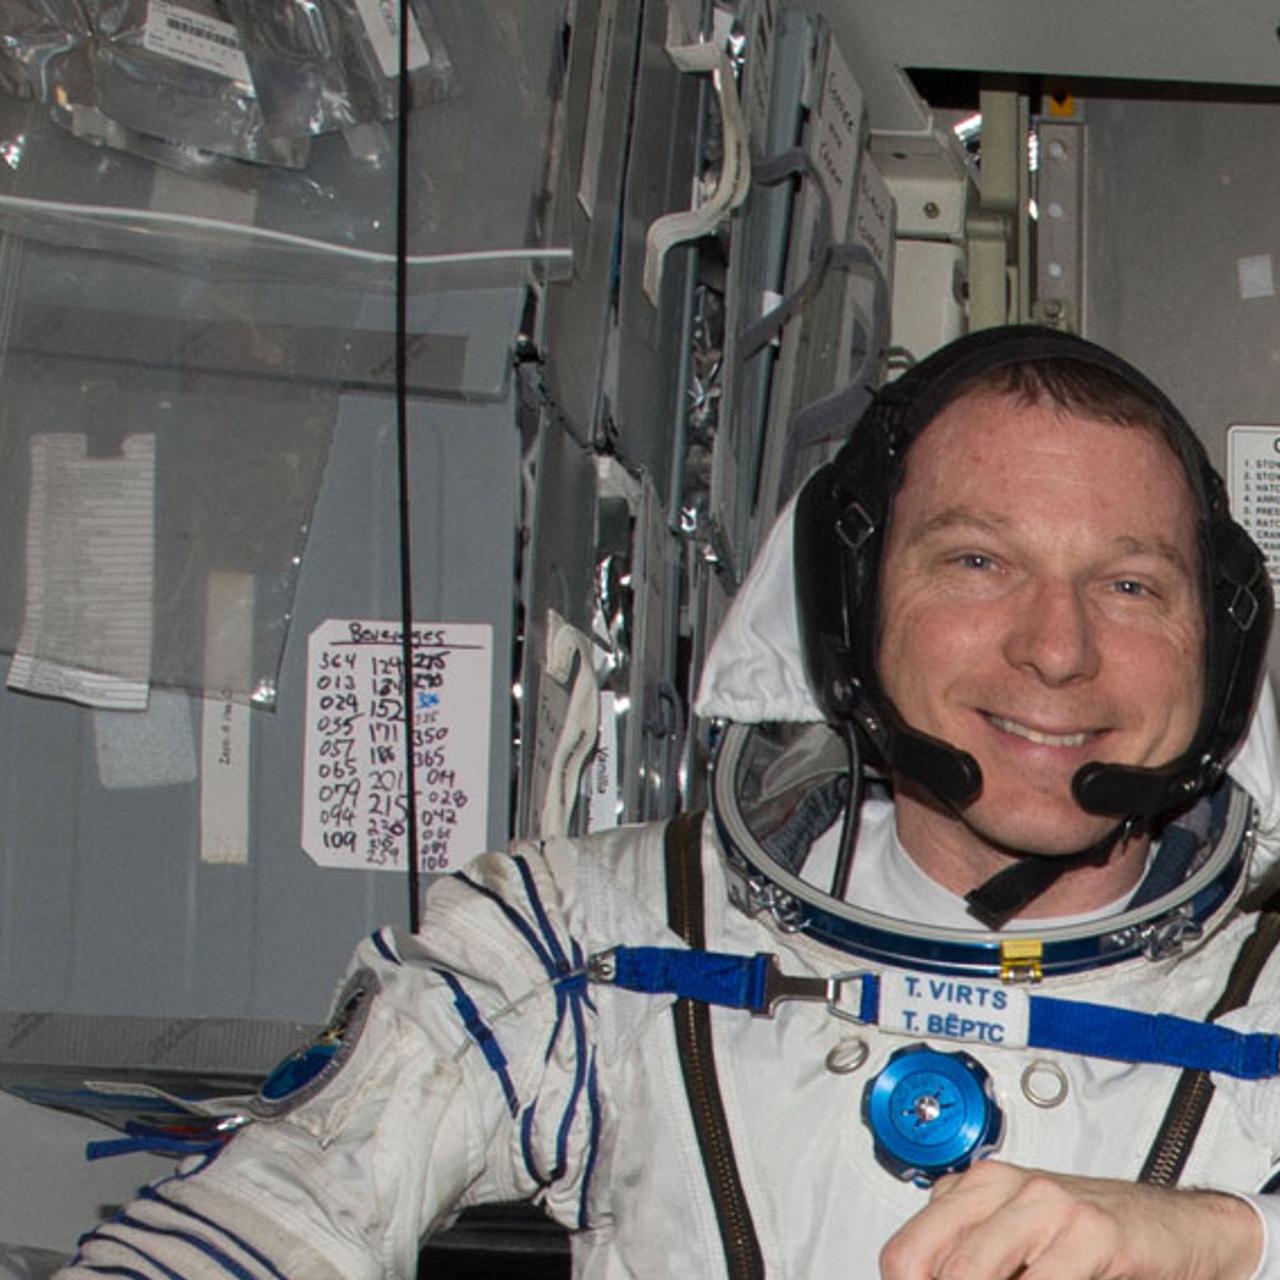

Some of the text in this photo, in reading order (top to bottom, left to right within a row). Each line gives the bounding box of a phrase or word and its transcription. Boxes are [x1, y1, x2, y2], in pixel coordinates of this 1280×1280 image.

[349, 623, 446, 646] Beverges
[317, 675, 355, 690] 013
[369, 722, 398, 742] 171
[319, 739, 355, 758] 057
[319, 758, 356, 778] 065
[319, 777, 361, 807] 079
[323, 831, 356, 853] 109
[905, 976, 1008, 1010] T. VIRTS
